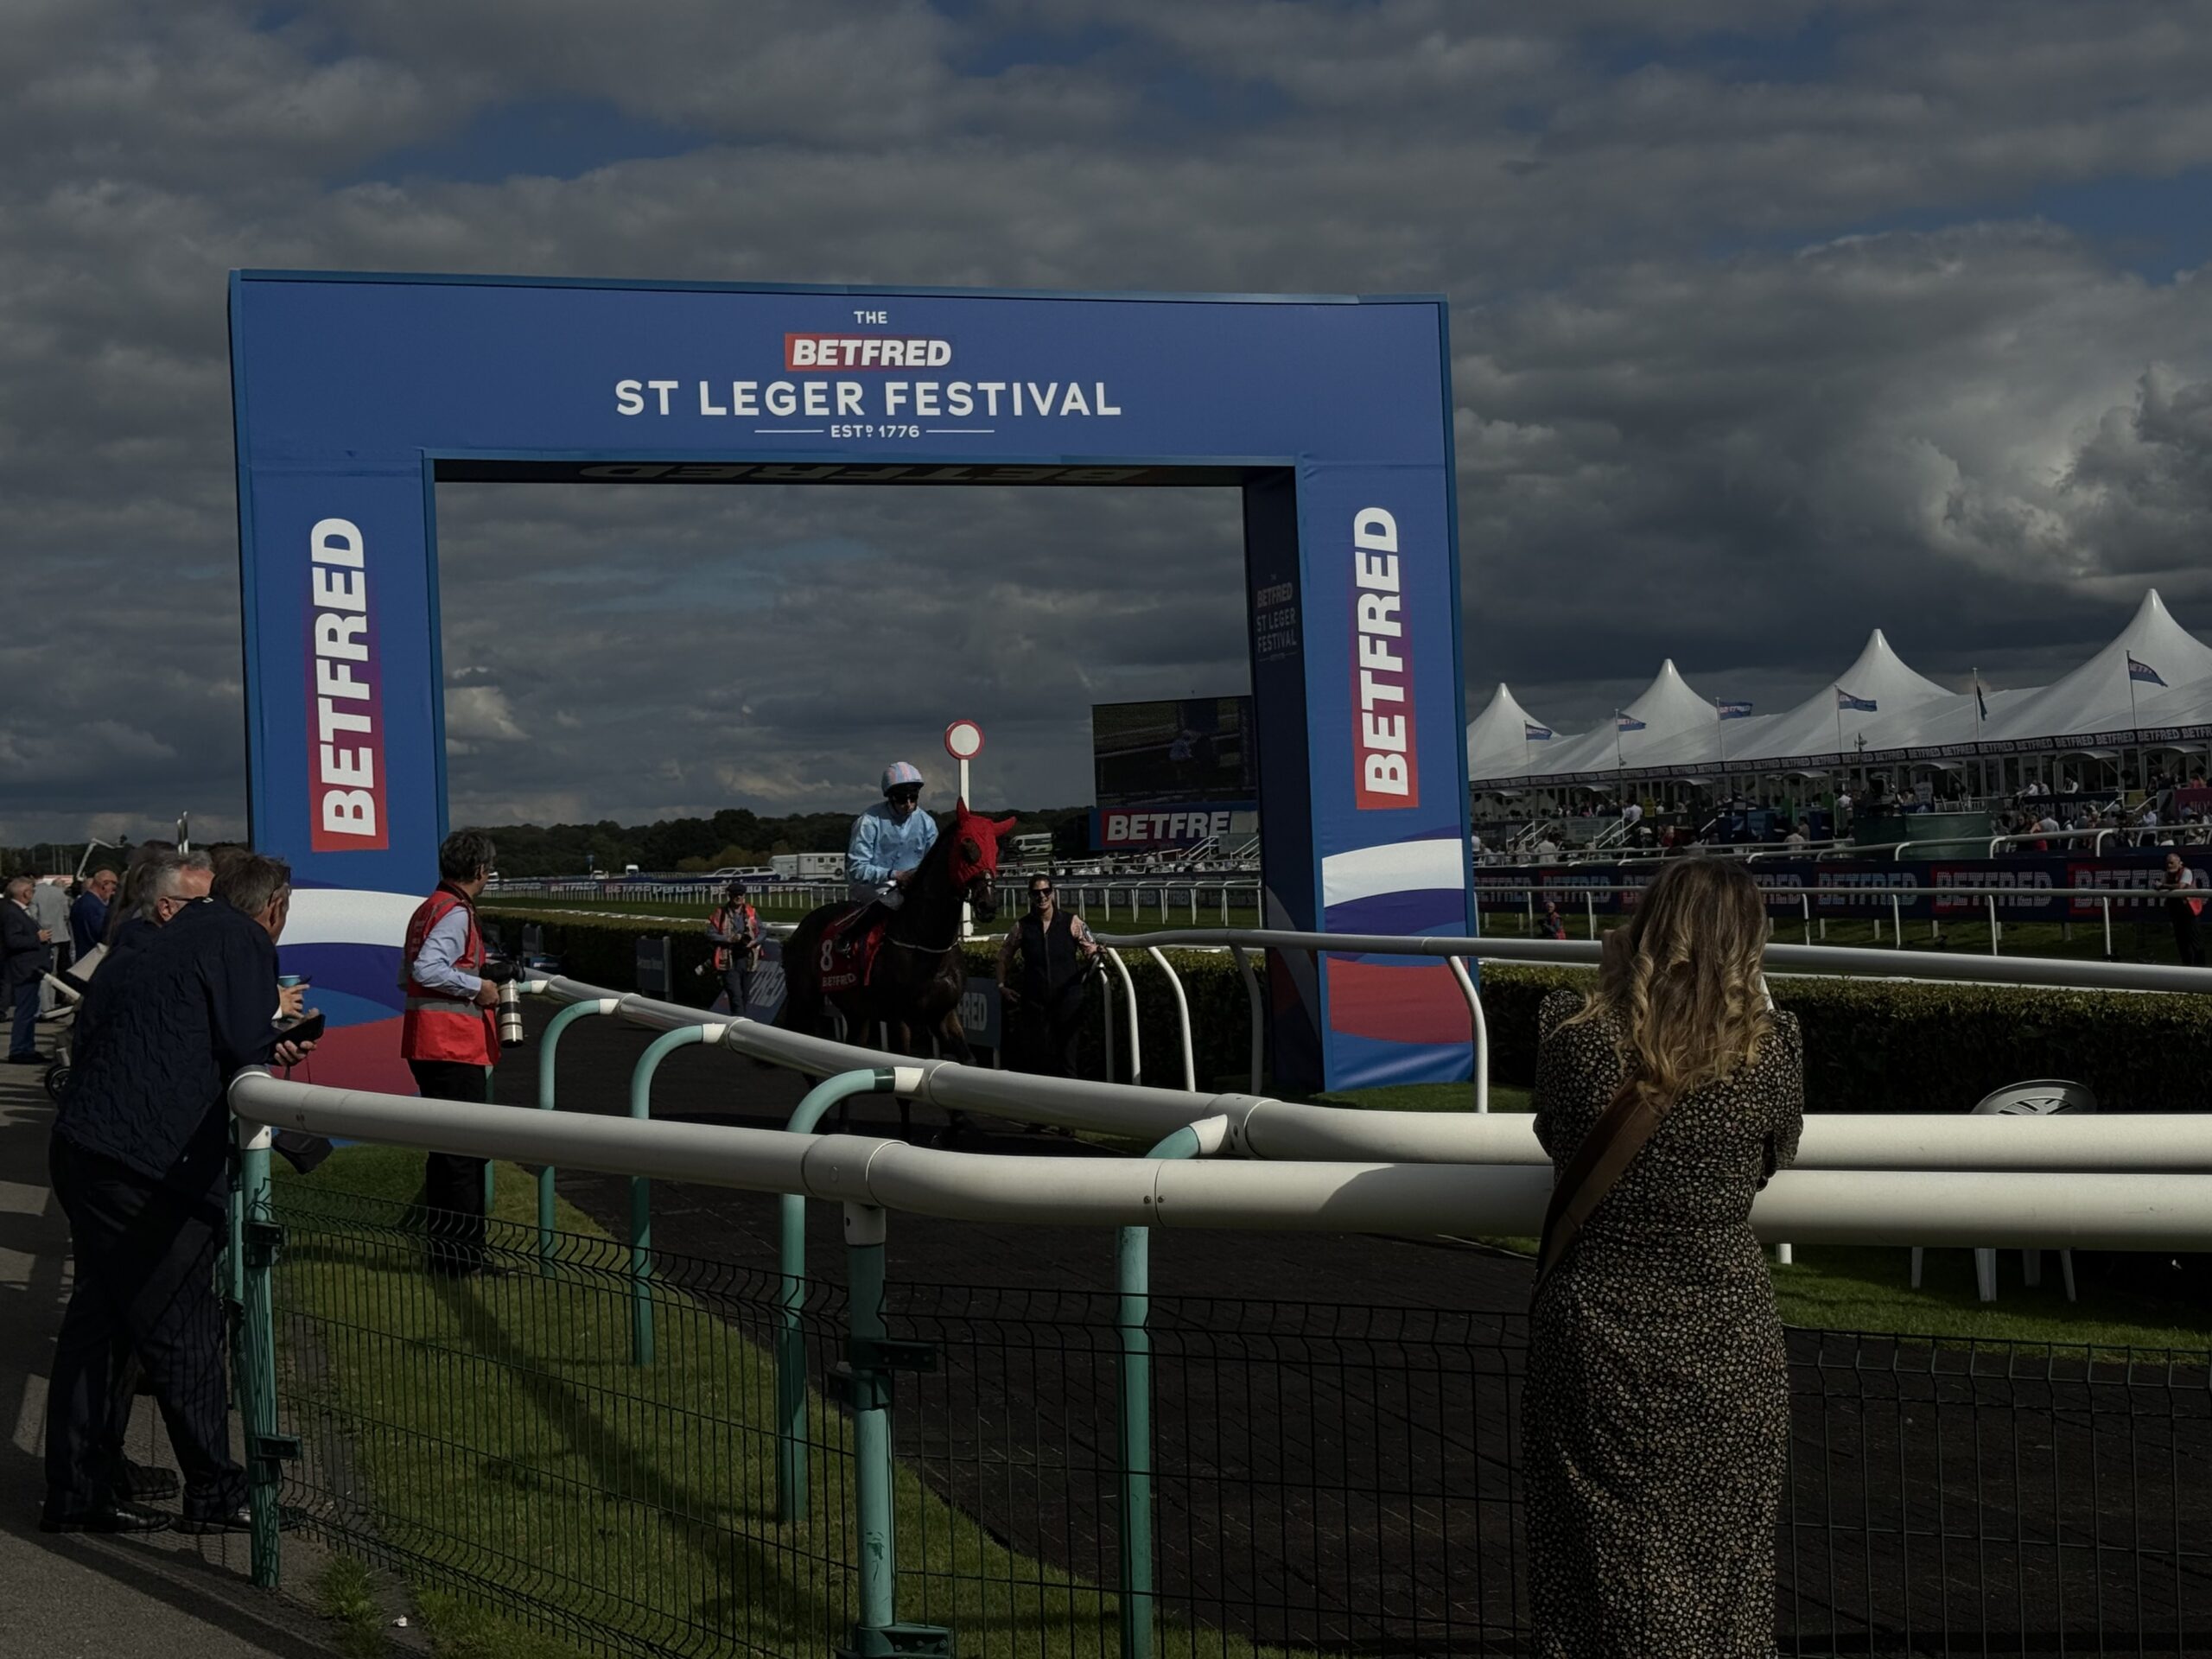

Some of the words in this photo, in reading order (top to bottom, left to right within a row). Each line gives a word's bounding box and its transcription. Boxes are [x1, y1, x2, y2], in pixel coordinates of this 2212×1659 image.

[854, 310, 888, 325] THE
[791, 339, 952, 367] BETFRED
[614, 379, 679, 416] ST
[699, 381, 865, 416] LEGER
[885, 381, 1122, 416] FESTIVAL
[878, 424, 920, 438] 1776
[1256, 582, 1294, 609] BETFRED
[1255, 613, 1267, 632] ST
[1268, 607, 1296, 630] LEGER
[1257, 629, 1297, 654] FESTIVAL
[1353, 506, 1410, 797] BETFRED
[309, 517, 378, 837] BETFRED
[1943, 743, 1977, 757] BETFRED
[1979, 741, 2015, 753] BETFRED
[2016, 738, 2053, 751] BETFRED
[2055, 734, 2094, 748] BETFRED
[2096, 732, 2135, 746] BETFRED
[2137, 728, 2179, 741] BETFRED
[1106, 810, 1230, 842] BETFRE
[1936, 871, 2053, 907] BETFRED
[2075, 868, 2210, 907] BETFRD
[820, 938, 834, 972] 8
